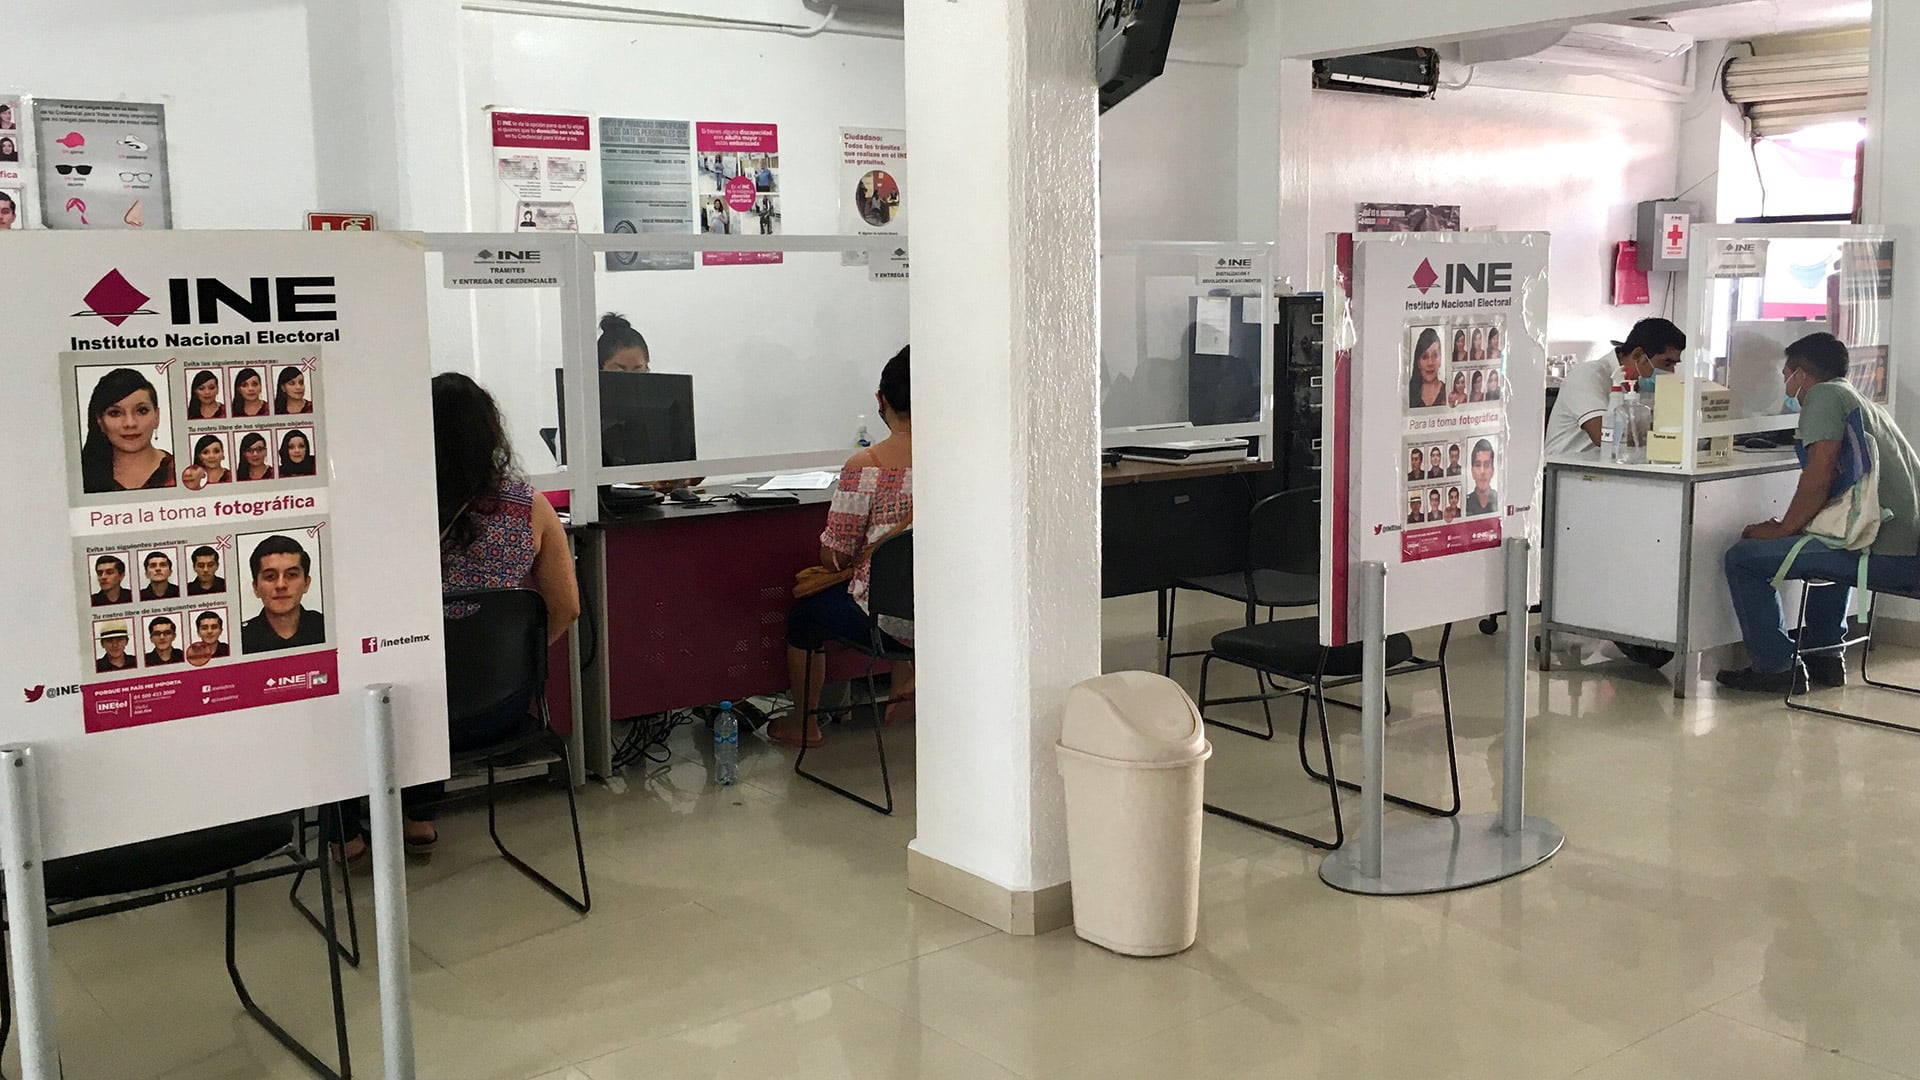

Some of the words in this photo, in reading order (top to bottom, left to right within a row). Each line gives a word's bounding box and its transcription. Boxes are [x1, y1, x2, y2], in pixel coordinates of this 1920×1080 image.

[1735, 243, 1756, 252] INE
[498, 251, 541, 260] INE
[1229, 258, 1252, 266] INE
[506, 277, 558, 285] CREDENCIALES
[1445, 262, 1512, 294] INE
[169, 277, 337, 325] INE
[1406, 301, 1439, 311] Instituto
[1442, 298, 1475, 309] Nacional
[1478, 296, 1512, 307] Electoral
[71, 336, 158, 351] Instituto
[166, 331, 250, 348] Nacional
[258, 328, 340, 344] Electoral
[1409, 419, 1427, 430] Para
[1429, 418, 1436, 428] la
[1437, 417, 1457, 428] toma
[1459, 412, 1499, 426] fotográfica
[90, 510, 134, 527] Para
[138, 508, 154, 523] la
[160, 506, 207, 522] toma
[214, 495, 315, 517] fotográfica
[381, 634, 430, 648] /inetelmx
[278, 674, 306, 686] INE
[46, 684, 81, 699] @INE
[95, 687, 121, 696] PORQUE
[155, 680, 182, 688] IMPORTA
[98, 700, 128, 711] INEtel
